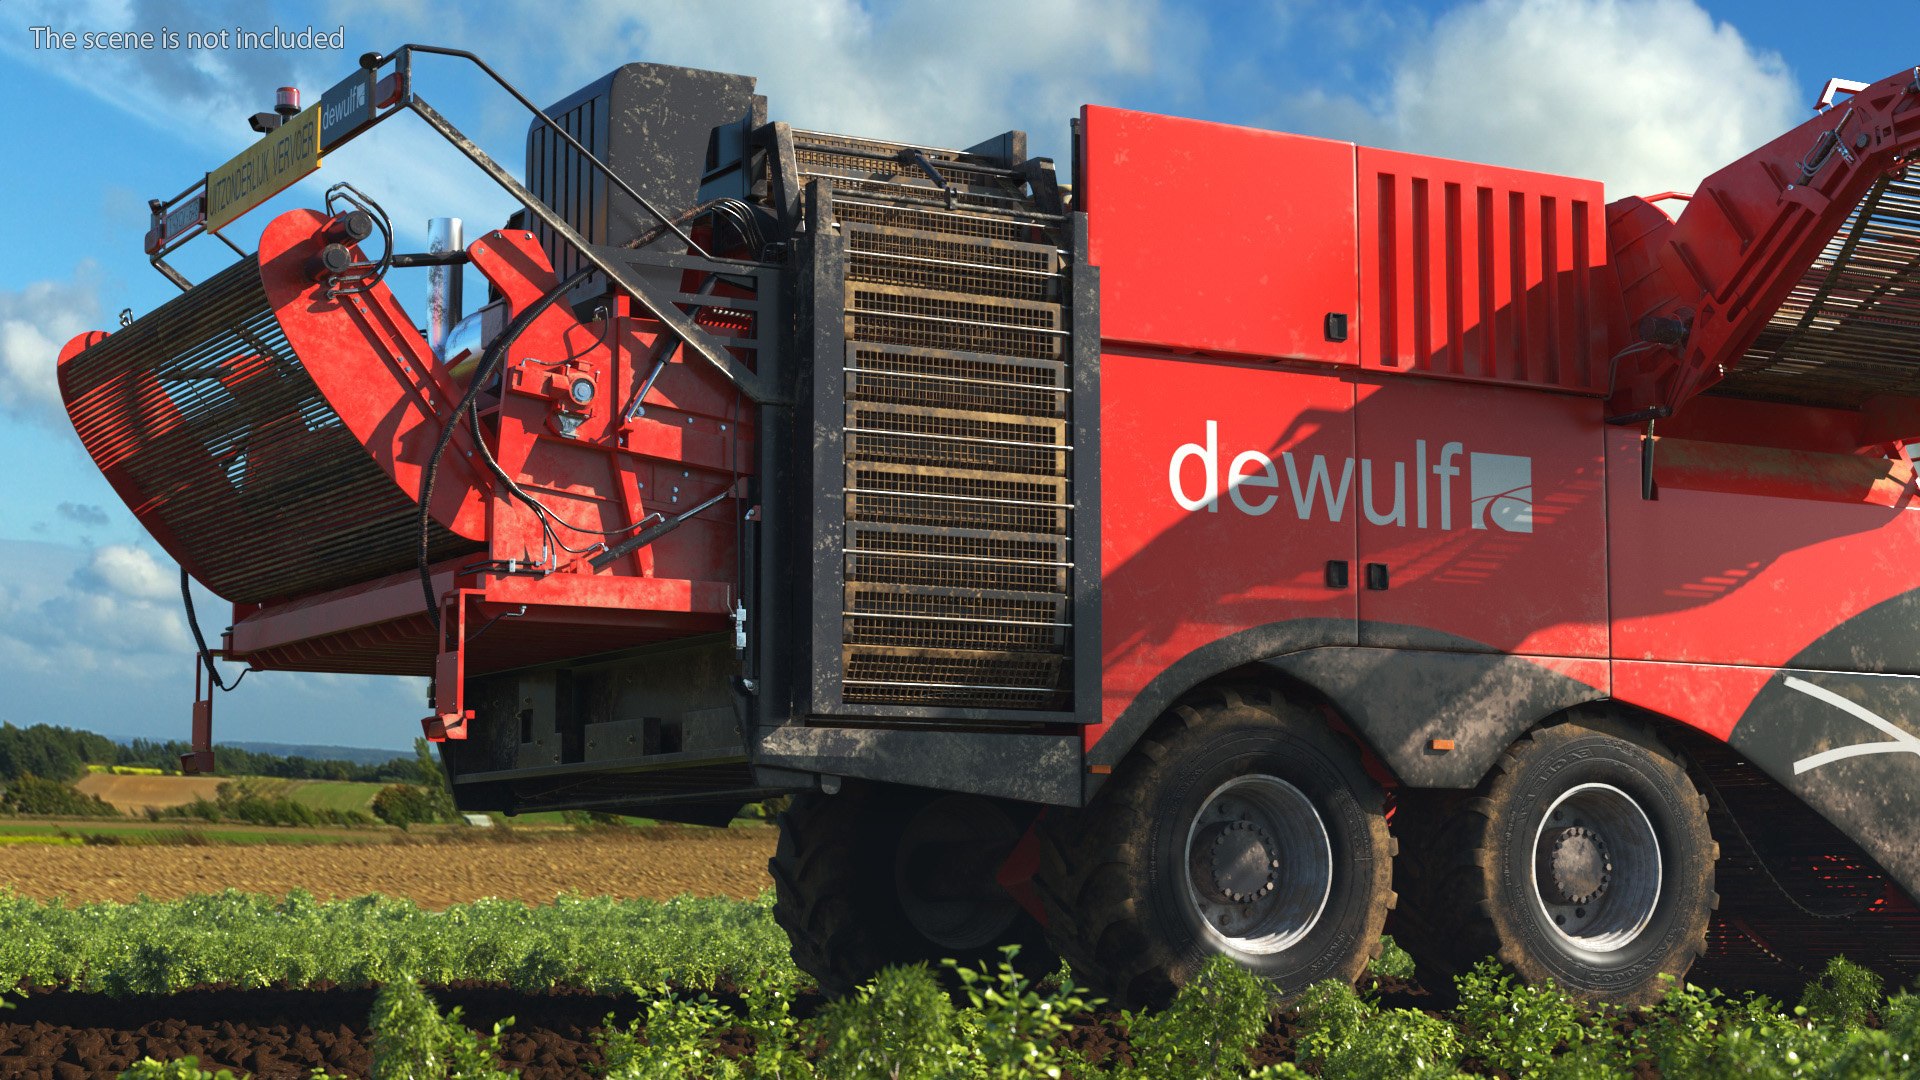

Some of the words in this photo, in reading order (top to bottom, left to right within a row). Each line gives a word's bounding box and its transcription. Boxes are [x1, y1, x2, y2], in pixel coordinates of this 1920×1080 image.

[323, 84, 357, 130] dewulf
[209, 149, 270, 217] UITZONDERLIJK
[273, 121, 314, 176] VERVOER
[1168, 419, 1463, 531] dewulf
